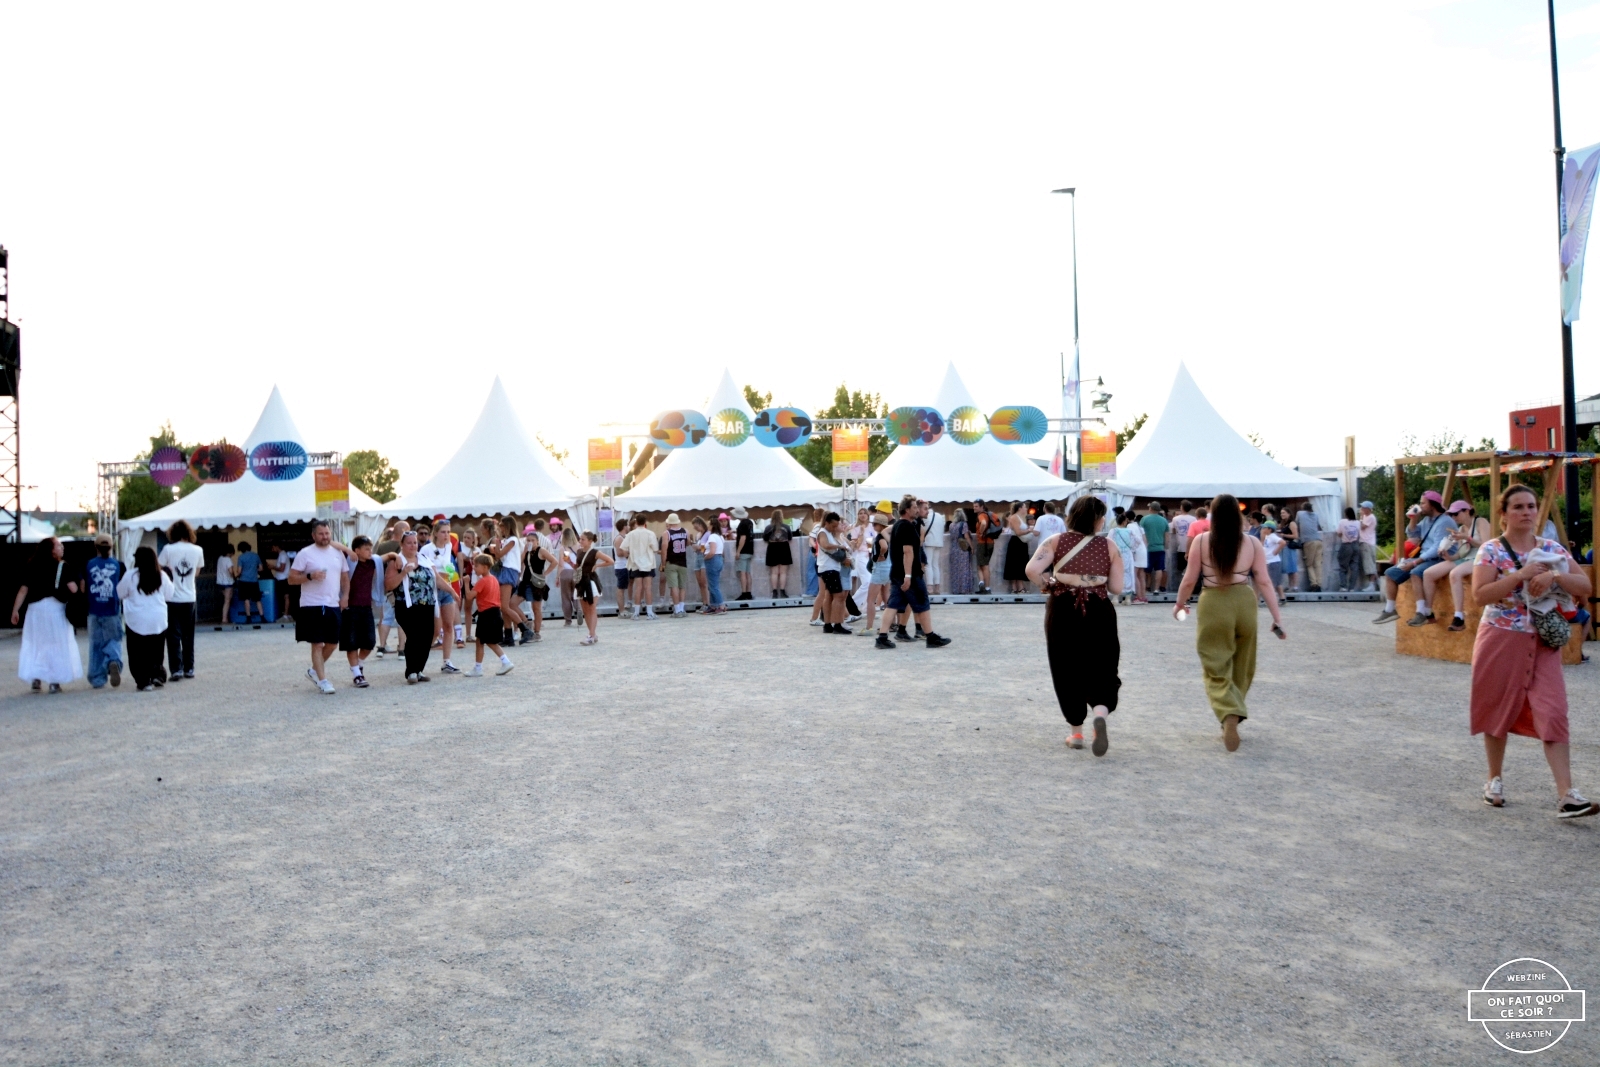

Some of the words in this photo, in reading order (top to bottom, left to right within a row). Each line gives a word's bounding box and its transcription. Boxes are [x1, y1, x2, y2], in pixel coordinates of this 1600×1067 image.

[717, 420, 744, 434] BAR
[252, 456, 304, 466] BATTERIES
[150, 462, 187, 471] CASIERS
